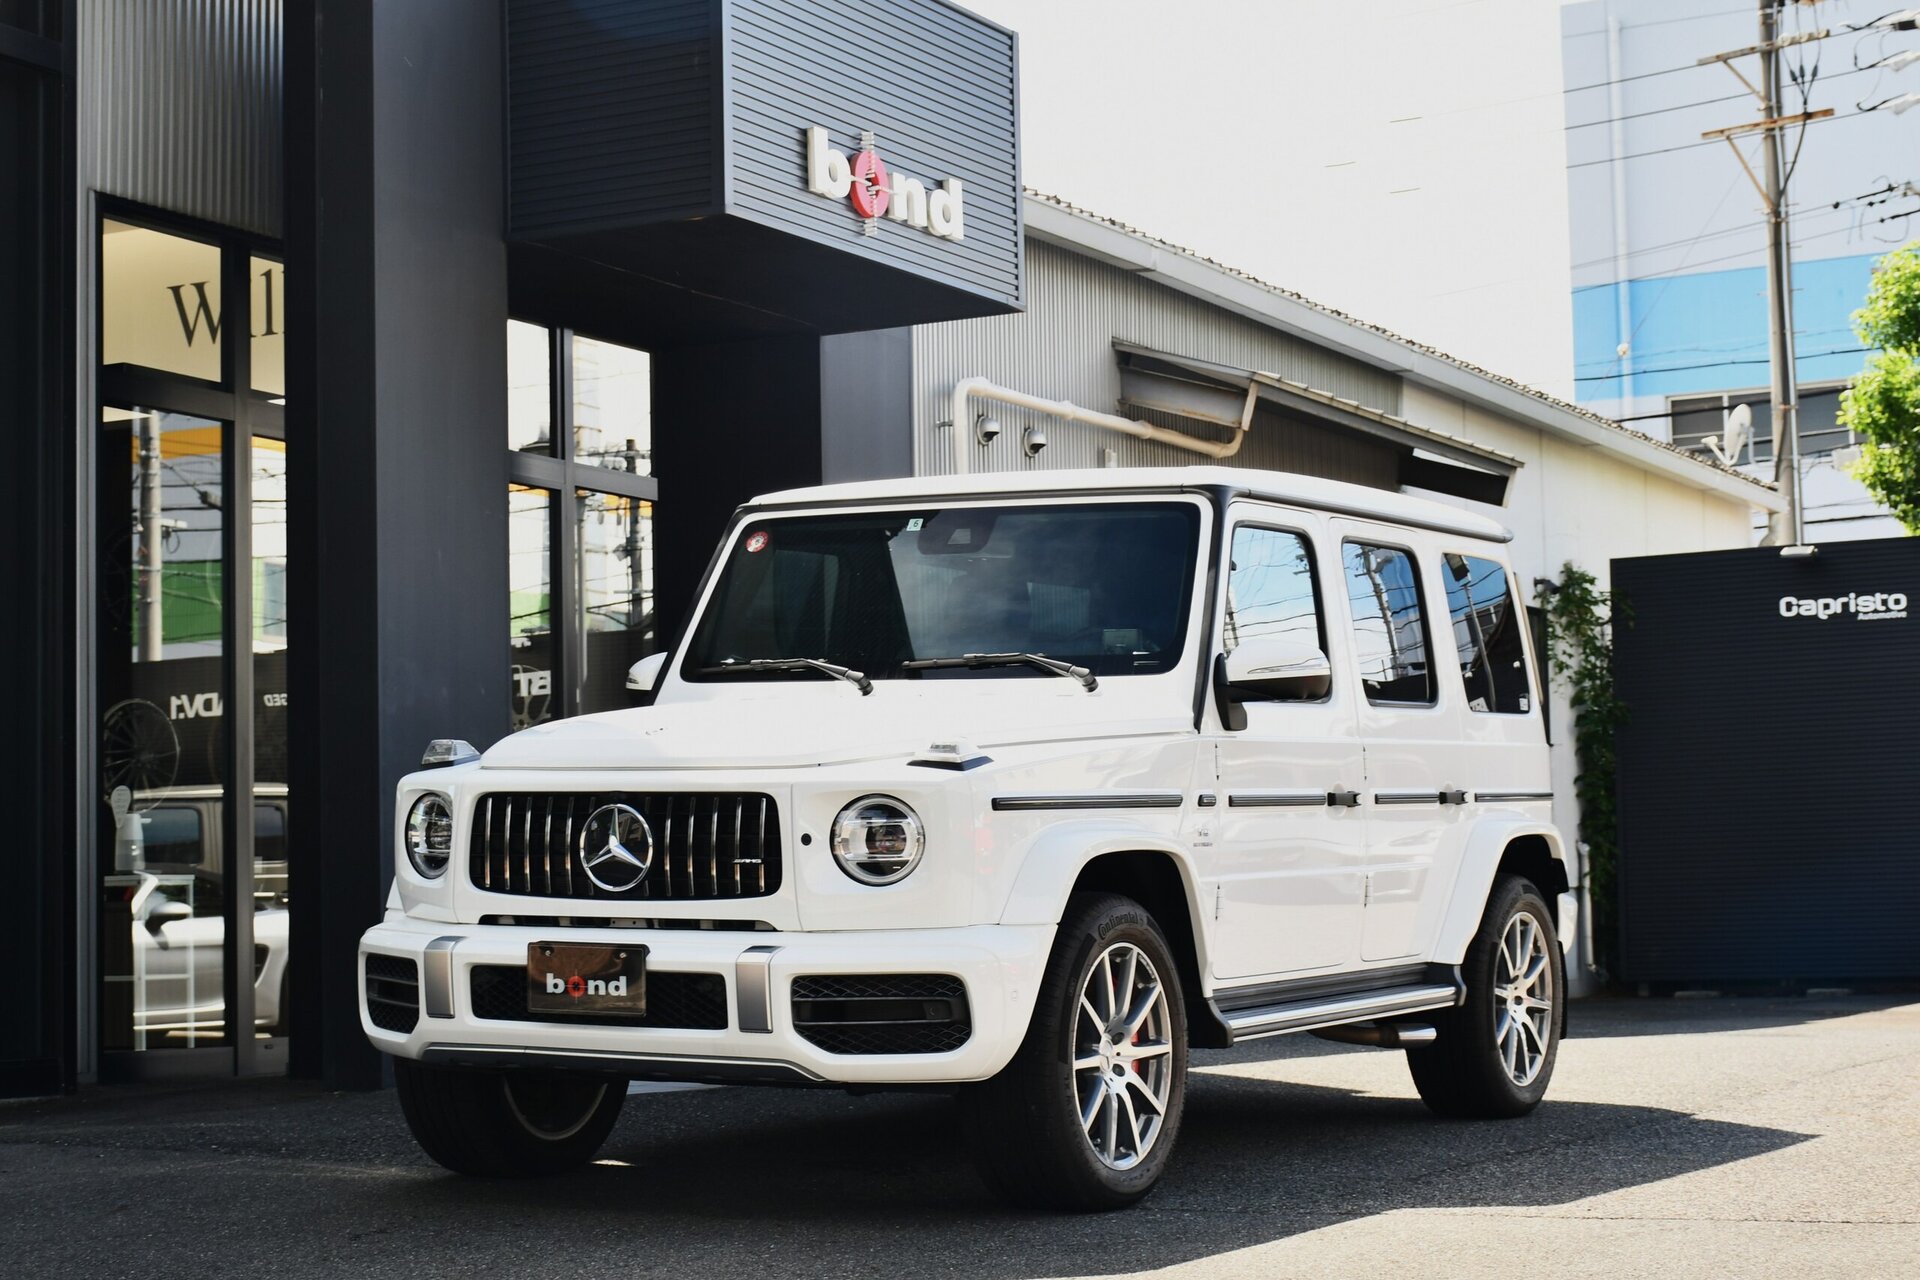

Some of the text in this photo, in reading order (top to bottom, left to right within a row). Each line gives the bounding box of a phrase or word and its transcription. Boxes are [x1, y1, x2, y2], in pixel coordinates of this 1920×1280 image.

[806, 126, 964, 241] bond
[1779, 592, 1908, 620] Capristo
[546, 972, 627, 997] bond
